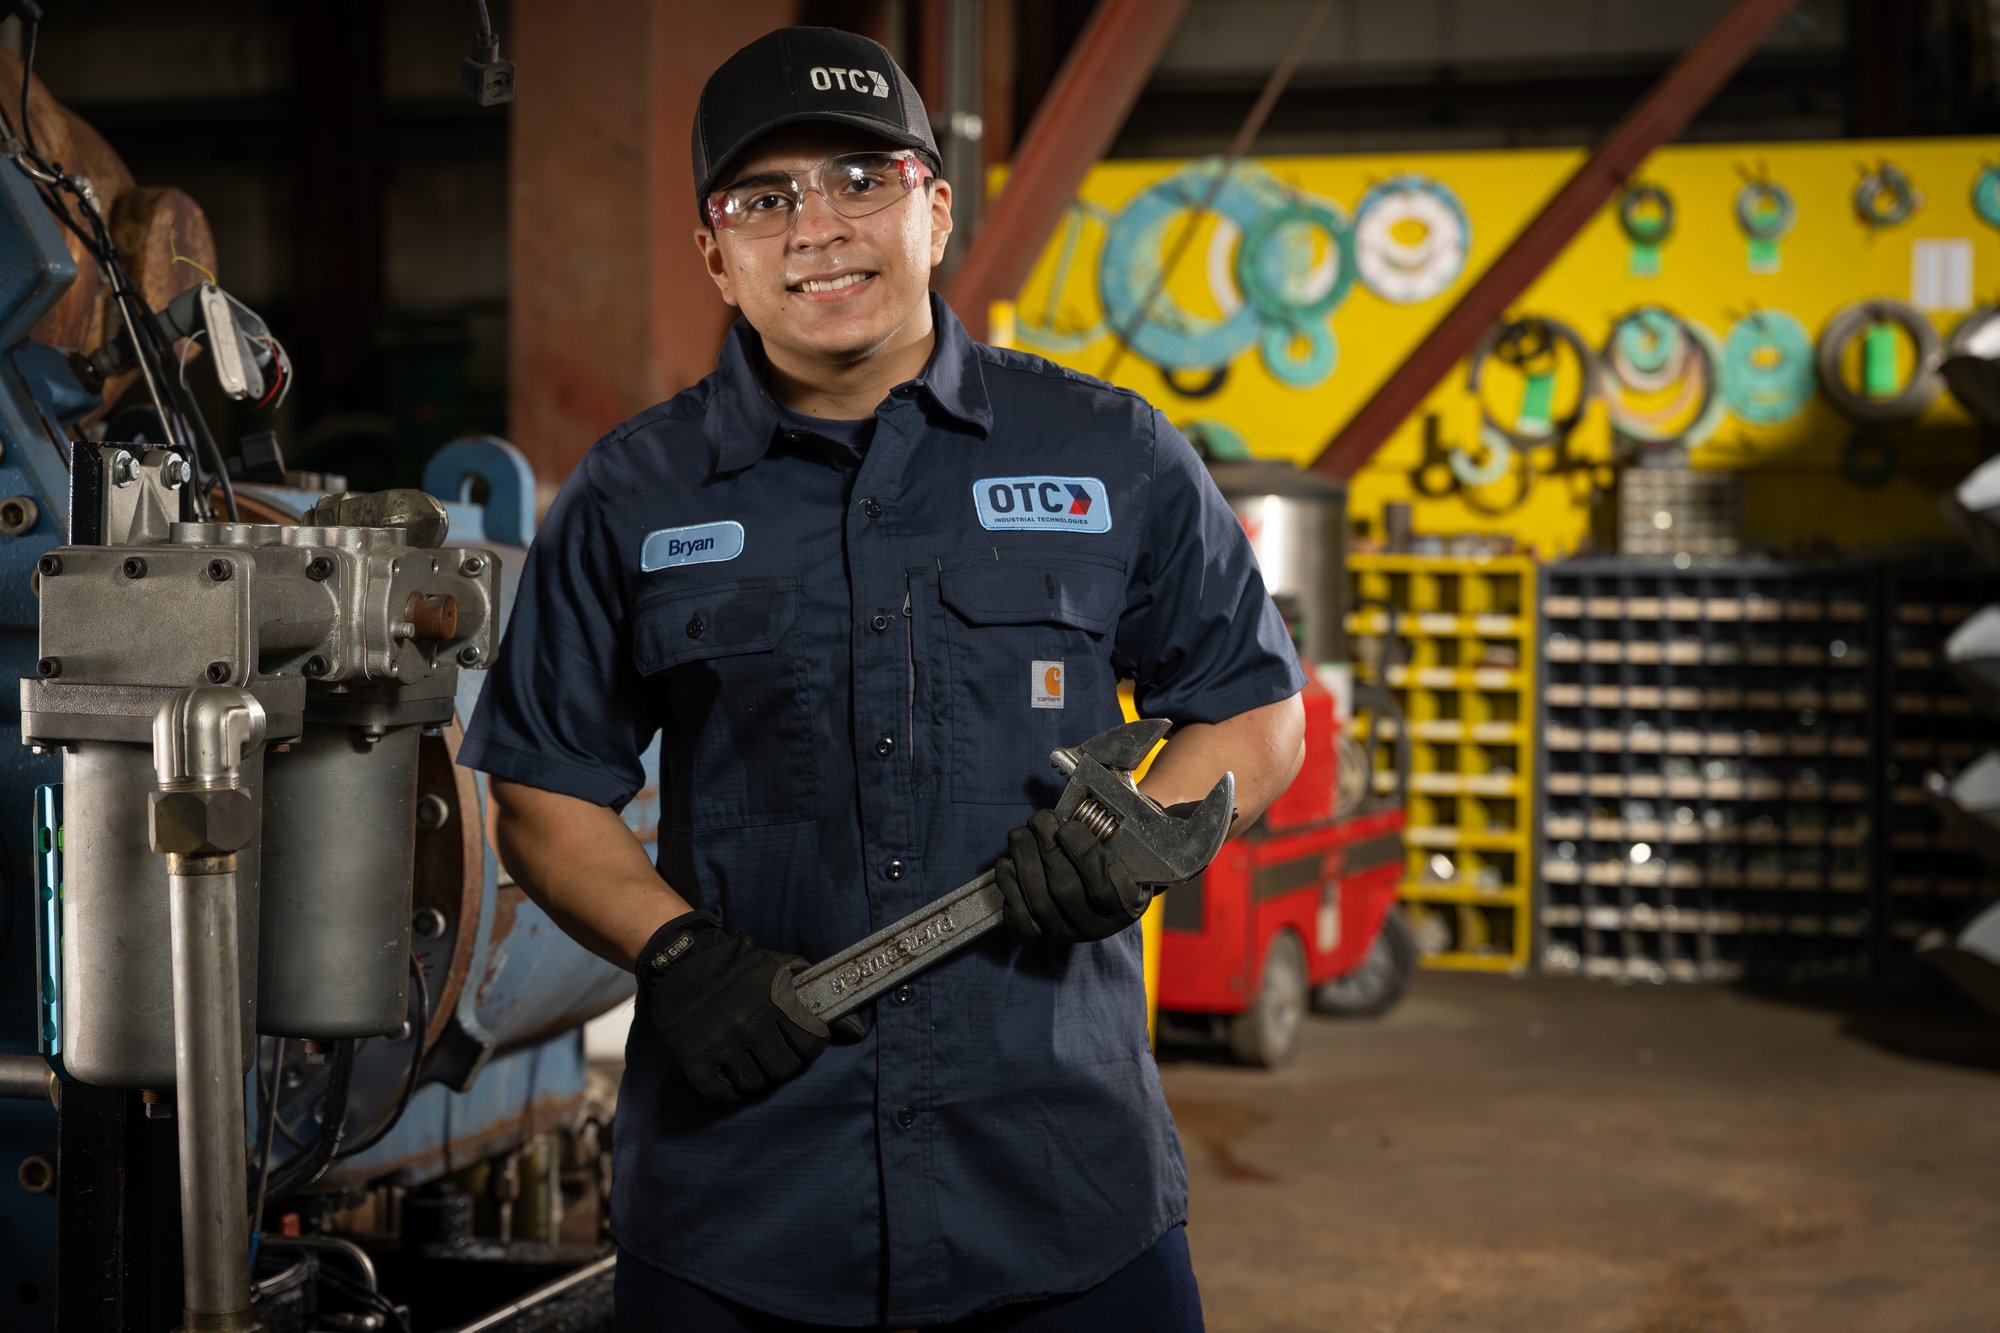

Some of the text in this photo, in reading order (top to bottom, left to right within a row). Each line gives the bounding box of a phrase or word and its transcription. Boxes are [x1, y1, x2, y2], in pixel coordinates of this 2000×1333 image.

[809, 66, 869, 94] OTC
[988, 482, 1064, 514] OTC
[1037, 516, 1089, 525] TECHNOLOGIES
[668, 537, 715, 557] Bryan
[668, 936, 690, 957] GRIP
[829, 914, 956, 996] PITTSBURGH
